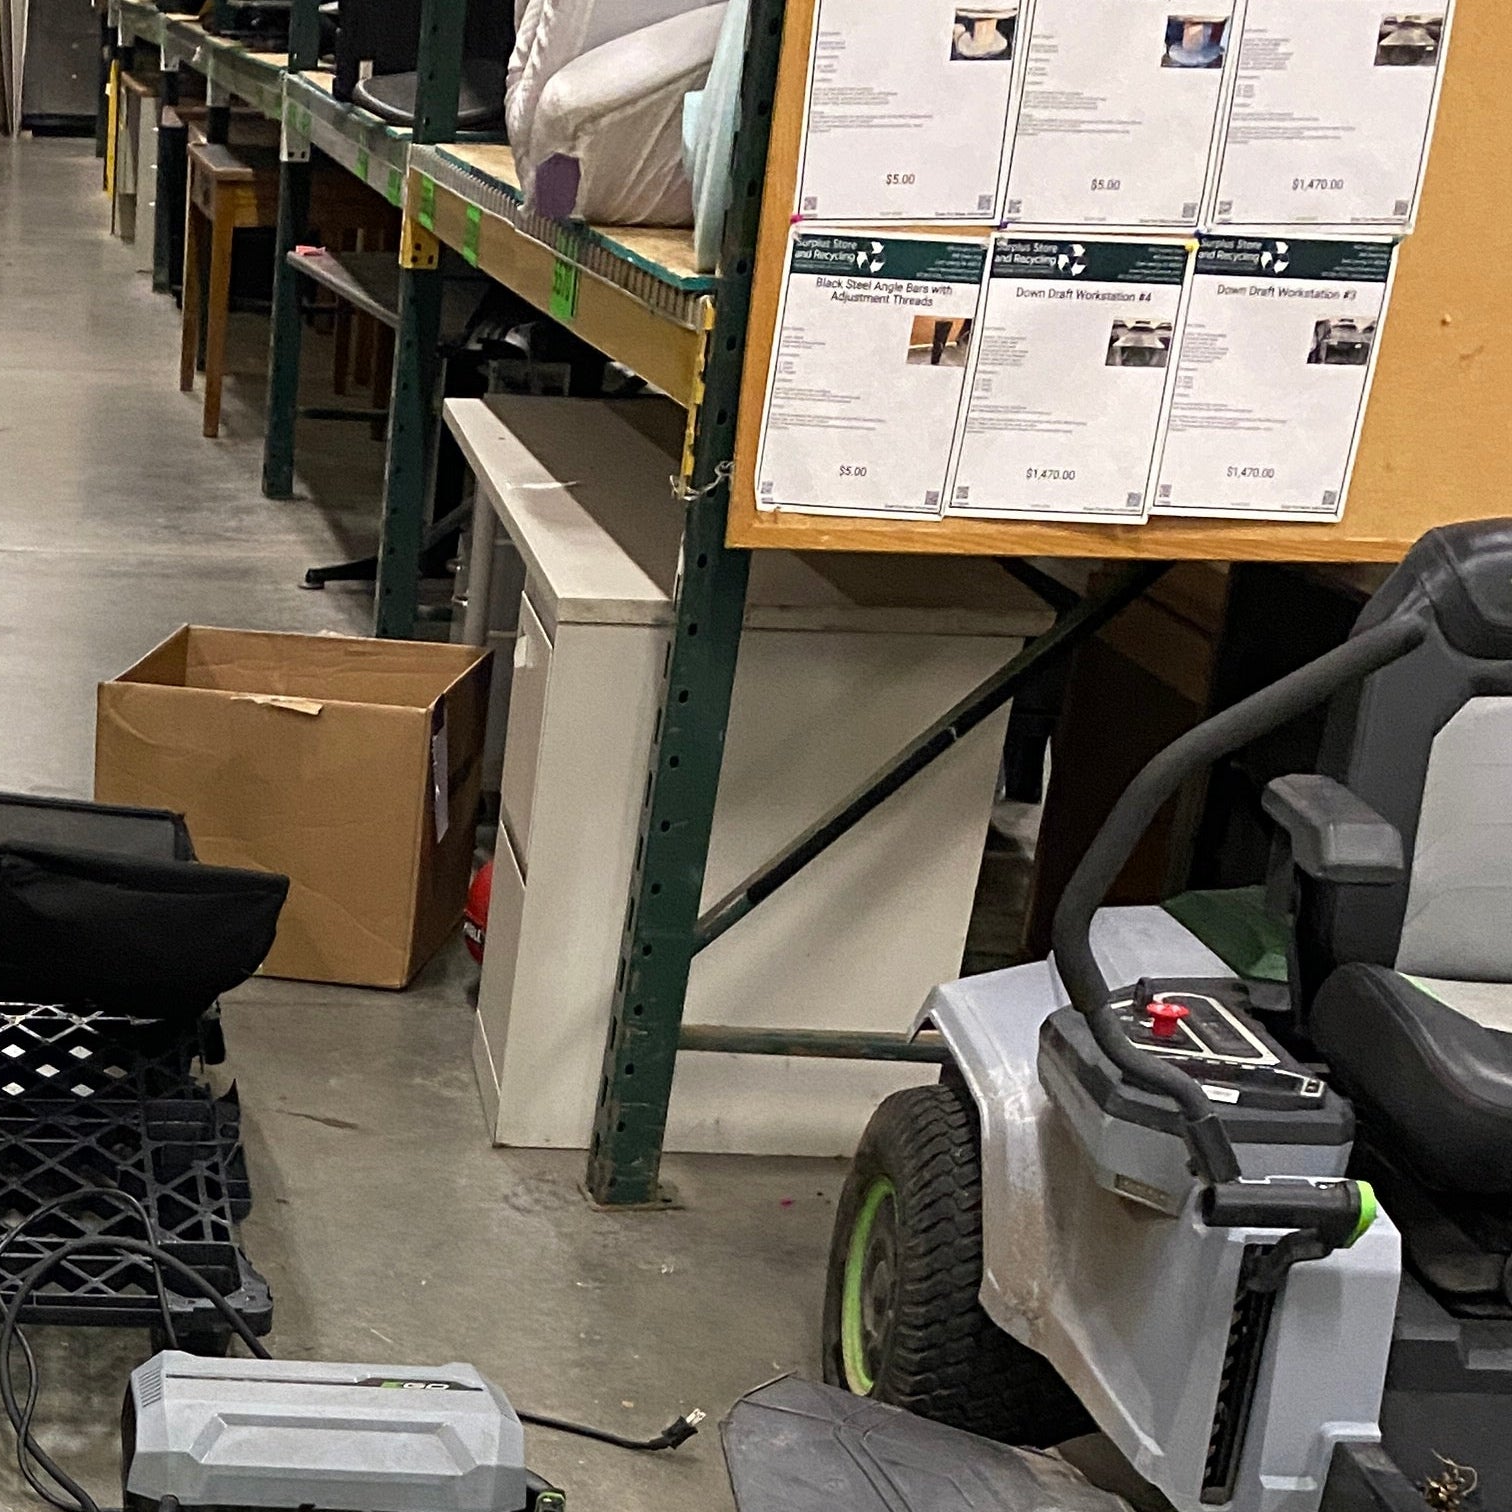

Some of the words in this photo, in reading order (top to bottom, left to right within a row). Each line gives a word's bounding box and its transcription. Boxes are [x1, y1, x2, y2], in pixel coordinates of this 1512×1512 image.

[886, 174, 915, 185] $5.00
[1091, 178, 1120, 191] $5.00
[1292, 178, 1344, 191] $1,470.00
[833, 239, 858, 250] Store
[1033, 243, 1059, 253] Store
[794, 250, 812, 259] and
[813, 249, 856, 263] Recycling
[994, 253, 1012, 263] and
[1013, 253, 1057, 267] Recycling
[1198, 250, 1216, 259] and
[1216, 250, 1260, 264] Recycling
[816, 277, 844, 289] Black
[845, 279, 872, 290] Steel
[874, 281, 904, 294] Angle
[906, 283, 929, 294] Bars
[931, 284, 953, 296] with
[1217, 284, 1247, 296] Down
[1249, 285, 1275, 297] Draft
[1278, 287, 1340, 299] Workstation
[831, 291, 890, 304] Adjustment
[892, 294, 933, 307] Threads
[1016, 287, 1045, 298] Down
[1048, 288, 1073, 299] Draft
[1076, 290, 1136, 301] Workstation
[1138, 292, 1152, 302] #4
[839, 465, 867, 477] $5.00
[1026, 468, 1076, 480] $1,470.00
[1227, 466, 1275, 478] $1,470.00
